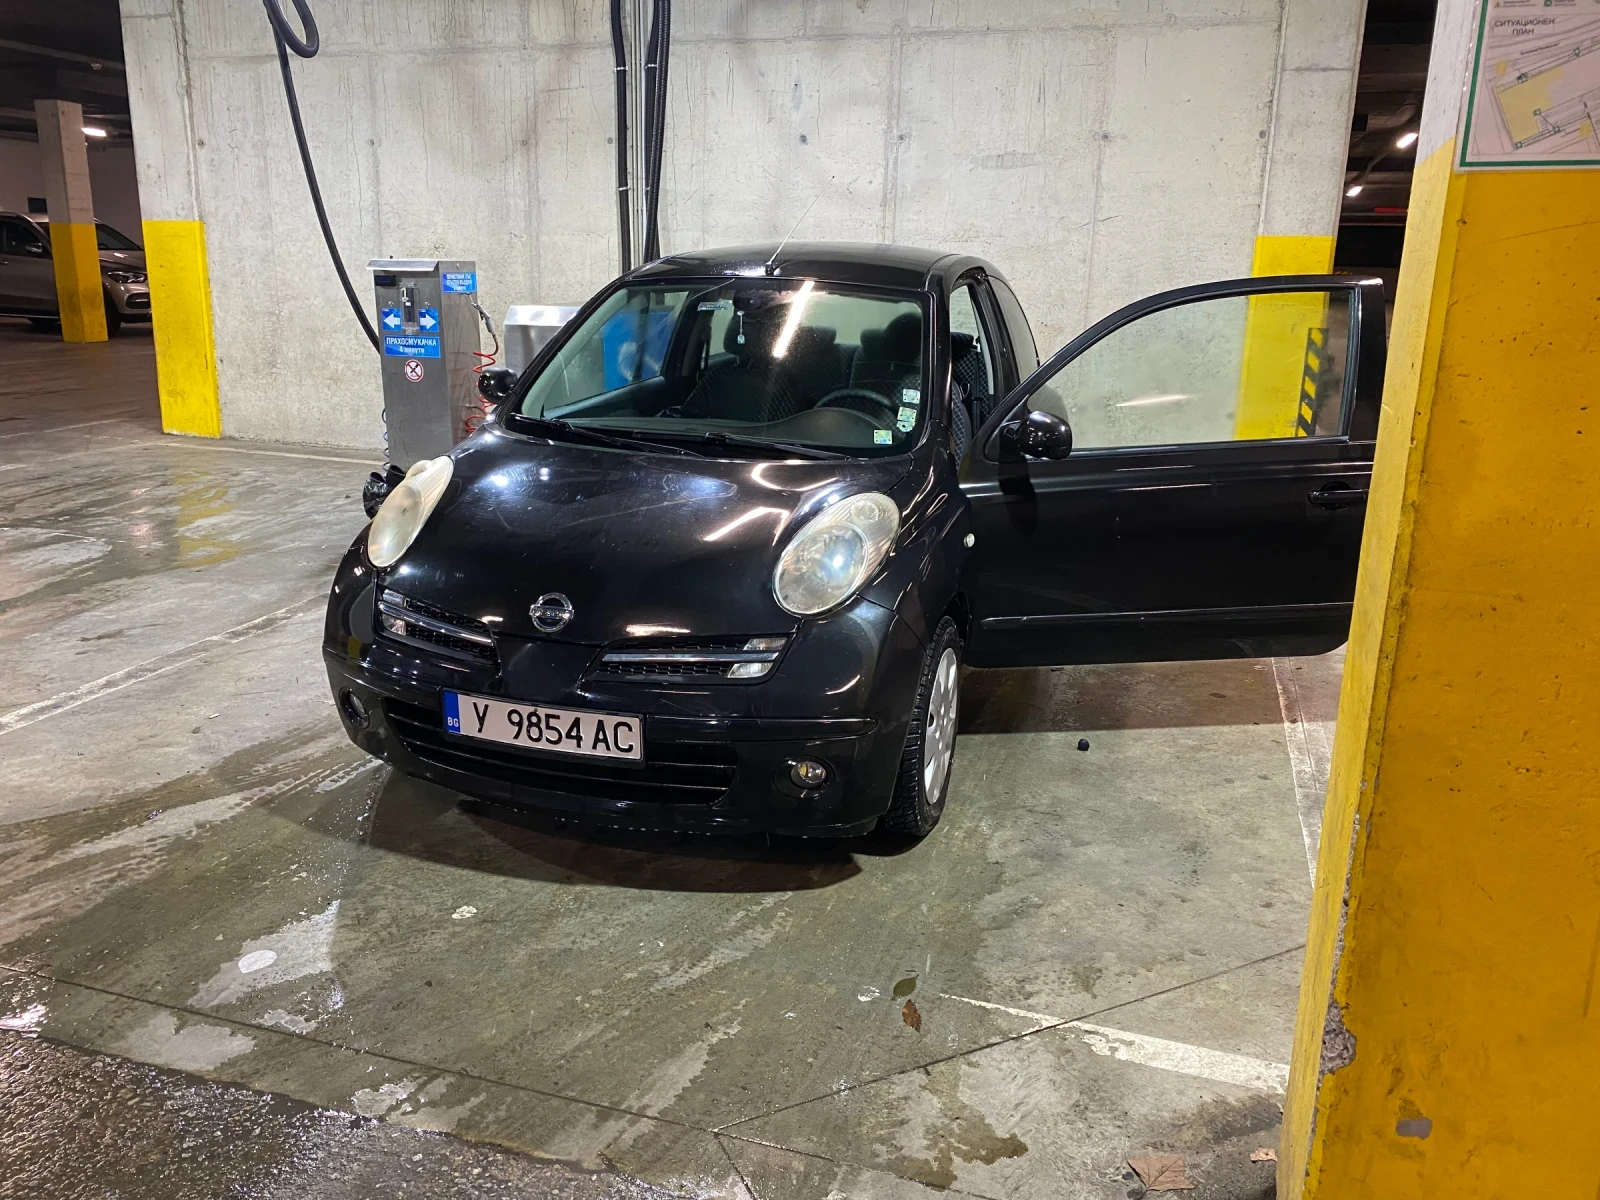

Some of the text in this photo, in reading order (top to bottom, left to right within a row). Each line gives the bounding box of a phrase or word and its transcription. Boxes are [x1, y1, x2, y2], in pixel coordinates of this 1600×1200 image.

[1494, 18, 1555, 27] СИТУАЦИОНЕН
[1512, 28, 1534, 36] ПЛАН
[386, 337, 437, 346] ПРАХОСМУКАЧКА
[404, 347, 425, 355] минути
[447, 716, 459, 728] BG
[507, 708, 583, 749] 9854
[591, 719, 634, 753] AC
